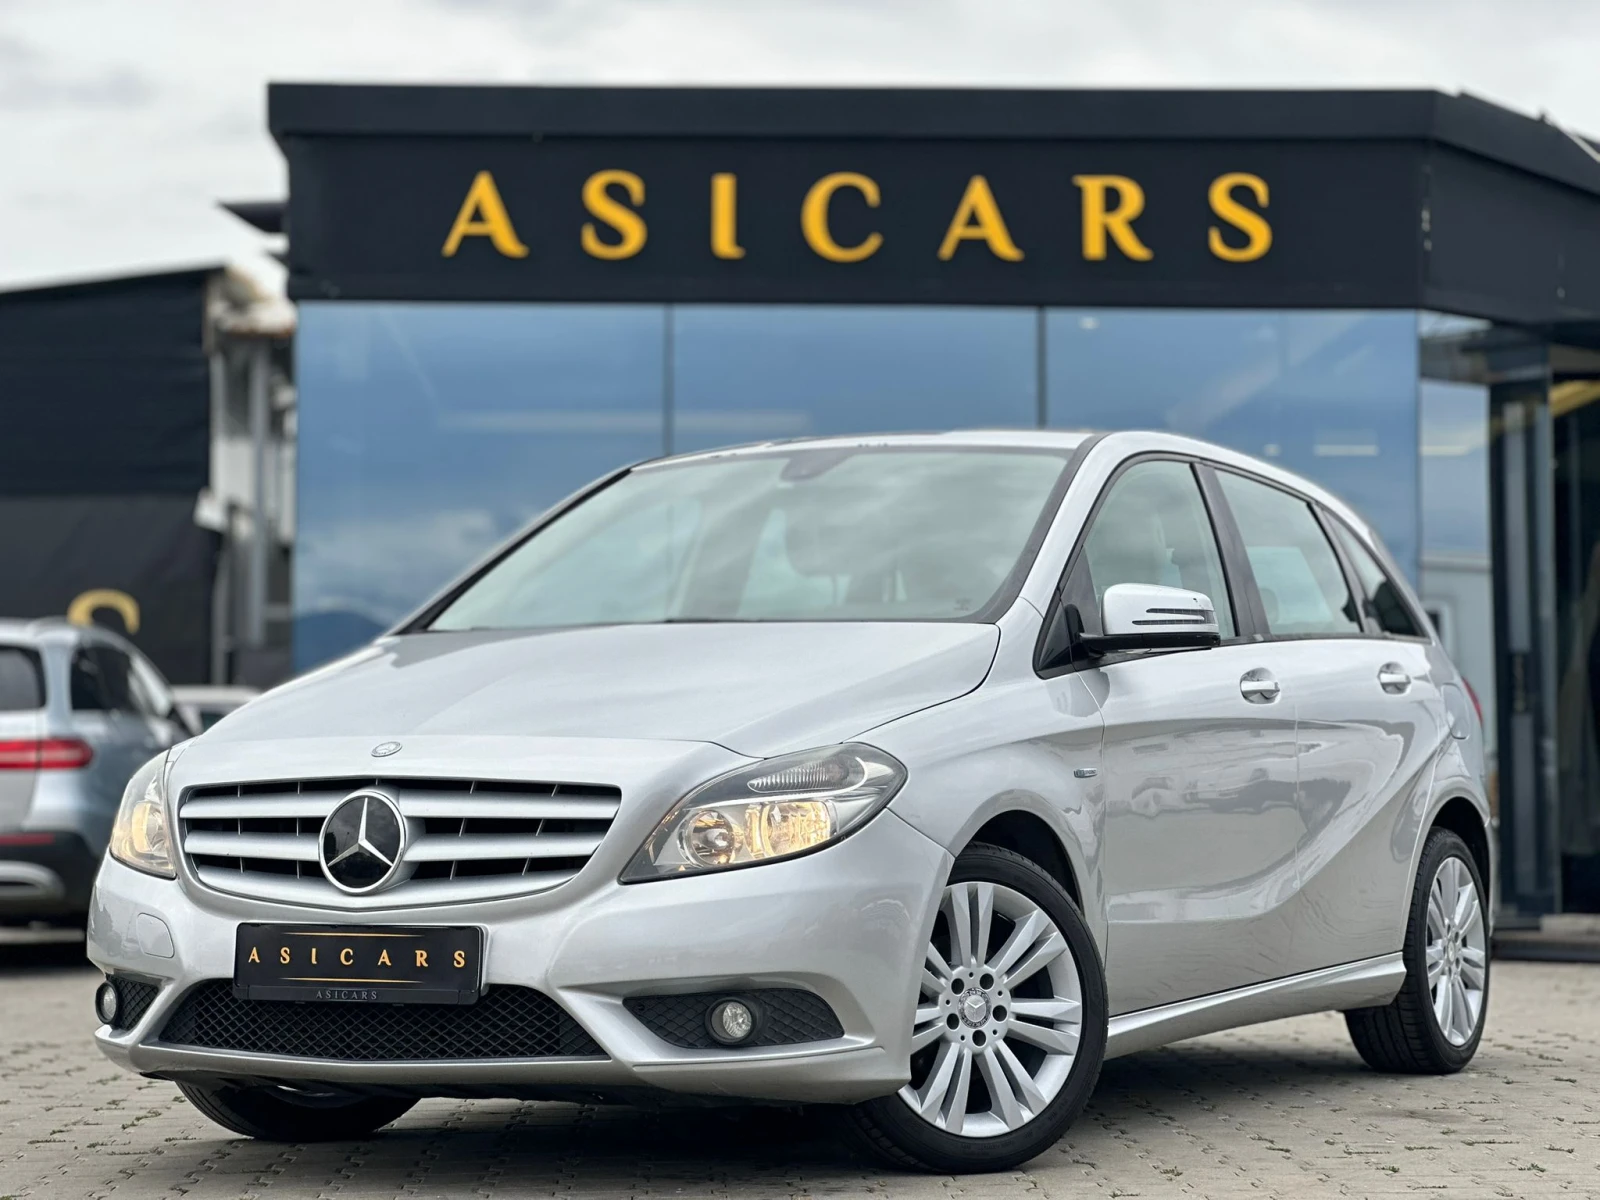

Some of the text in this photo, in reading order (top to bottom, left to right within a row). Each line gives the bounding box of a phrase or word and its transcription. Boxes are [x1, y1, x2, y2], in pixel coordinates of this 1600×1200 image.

[443, 170, 1272, 262] ASICARS
[248, 946, 466, 968] ASICARS
[315, 990, 377, 1000] ASICARS
